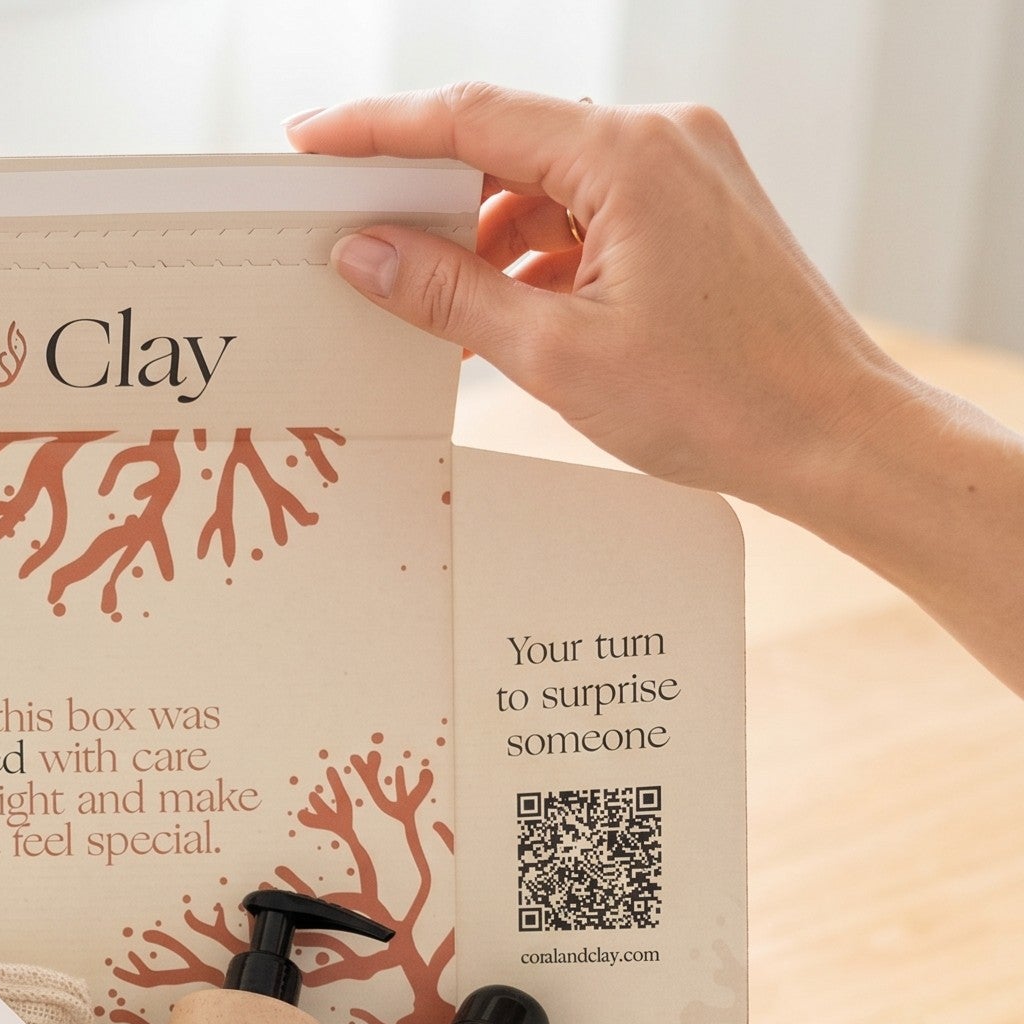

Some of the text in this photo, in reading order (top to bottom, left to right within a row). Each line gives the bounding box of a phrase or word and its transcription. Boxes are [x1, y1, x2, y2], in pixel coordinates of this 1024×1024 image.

[45, 306, 237, 404] Clay
[507, 633, 665, 666] Your turn
[496, 673, 682, 716] to surprise
[66, 696, 137, 732] box
[148, 706, 221, 730] was
[38, 737, 118, 774] with
[132, 748, 211, 772] care
[507, 726, 670, 757] someone
[77, 778, 146, 815] and
[159, 777, 263, 813] make
[11, 820, 74, 858] feel
[87, 819, 221, 867] special.
[520, 946, 660, 967] coralandclay.com
